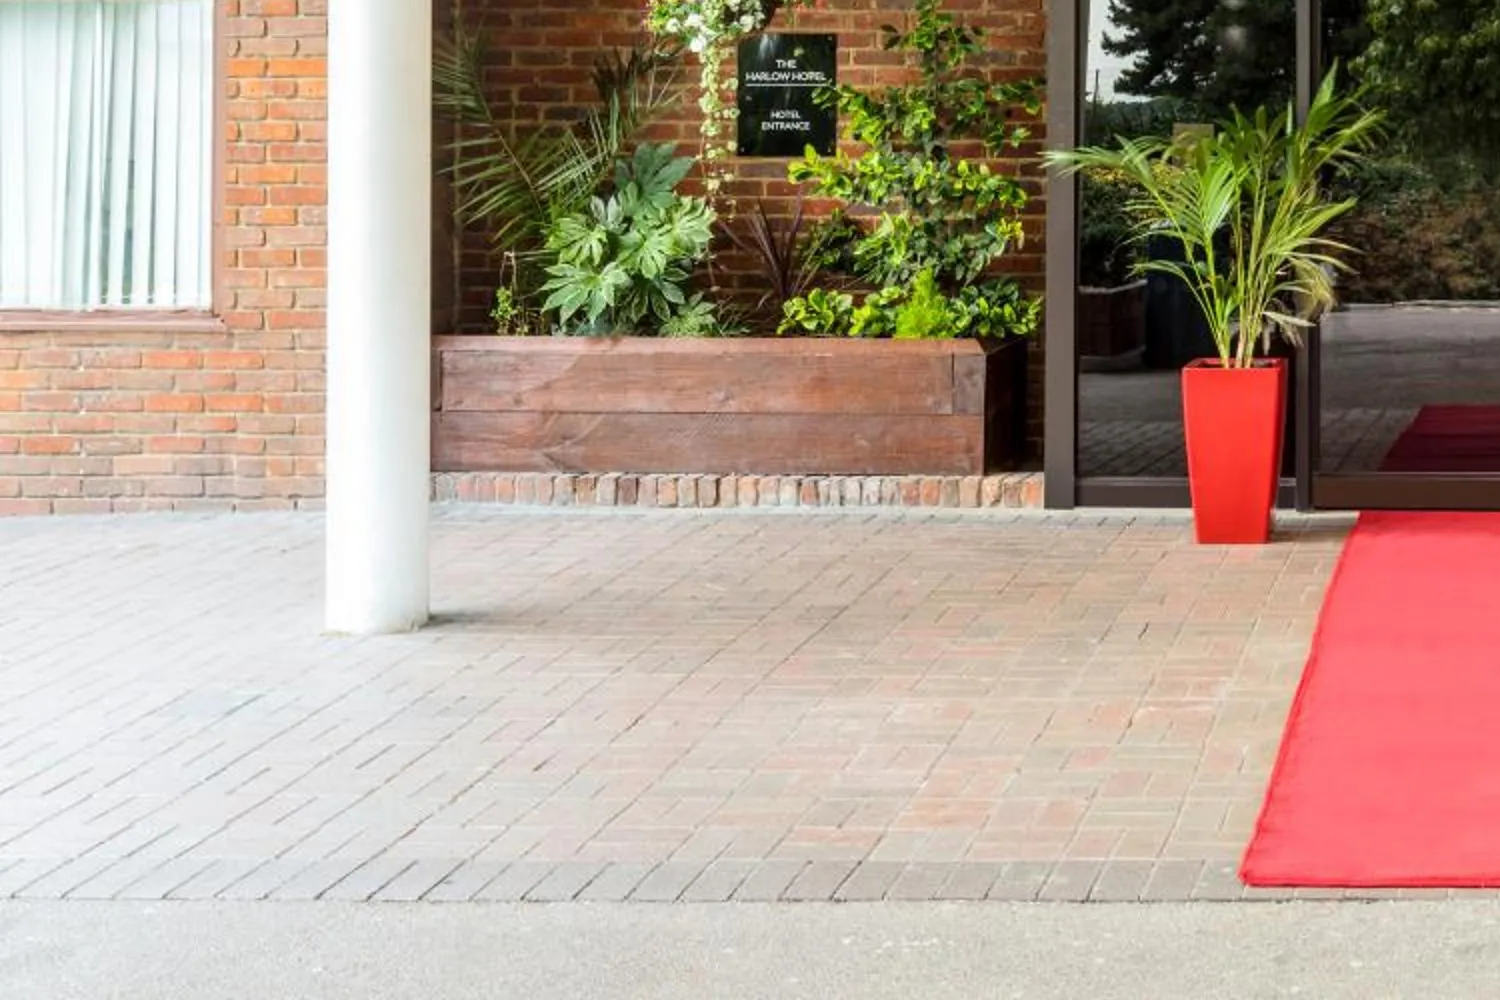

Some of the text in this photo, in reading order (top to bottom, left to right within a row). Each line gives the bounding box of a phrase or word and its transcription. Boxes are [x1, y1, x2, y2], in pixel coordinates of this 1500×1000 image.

[775, 59, 797, 69] THE
[745, 71, 827, 81] HARLOW HOTEL
[770, 109, 801, 119] HOTEL
[761, 121, 811, 131] ENTRANCE
